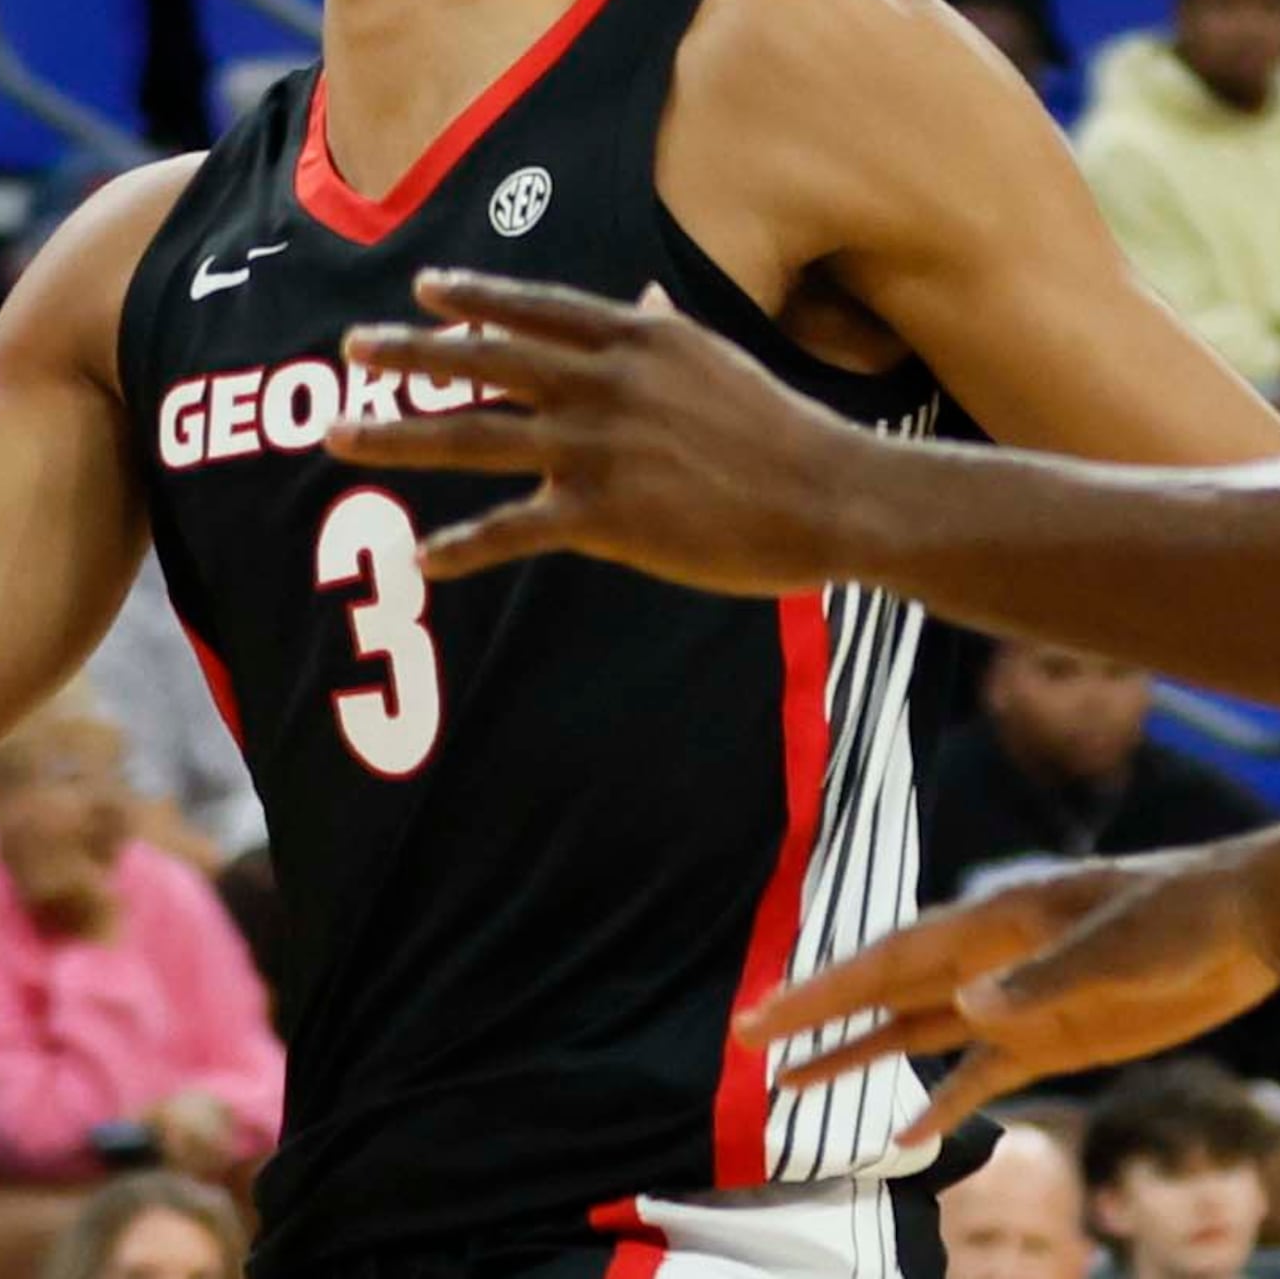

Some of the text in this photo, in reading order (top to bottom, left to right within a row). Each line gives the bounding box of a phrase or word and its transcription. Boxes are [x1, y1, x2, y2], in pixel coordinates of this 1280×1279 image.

[493, 173, 547, 231] SEC
[159, 320, 510, 470] GEORG
[313, 484, 444, 781] 3
